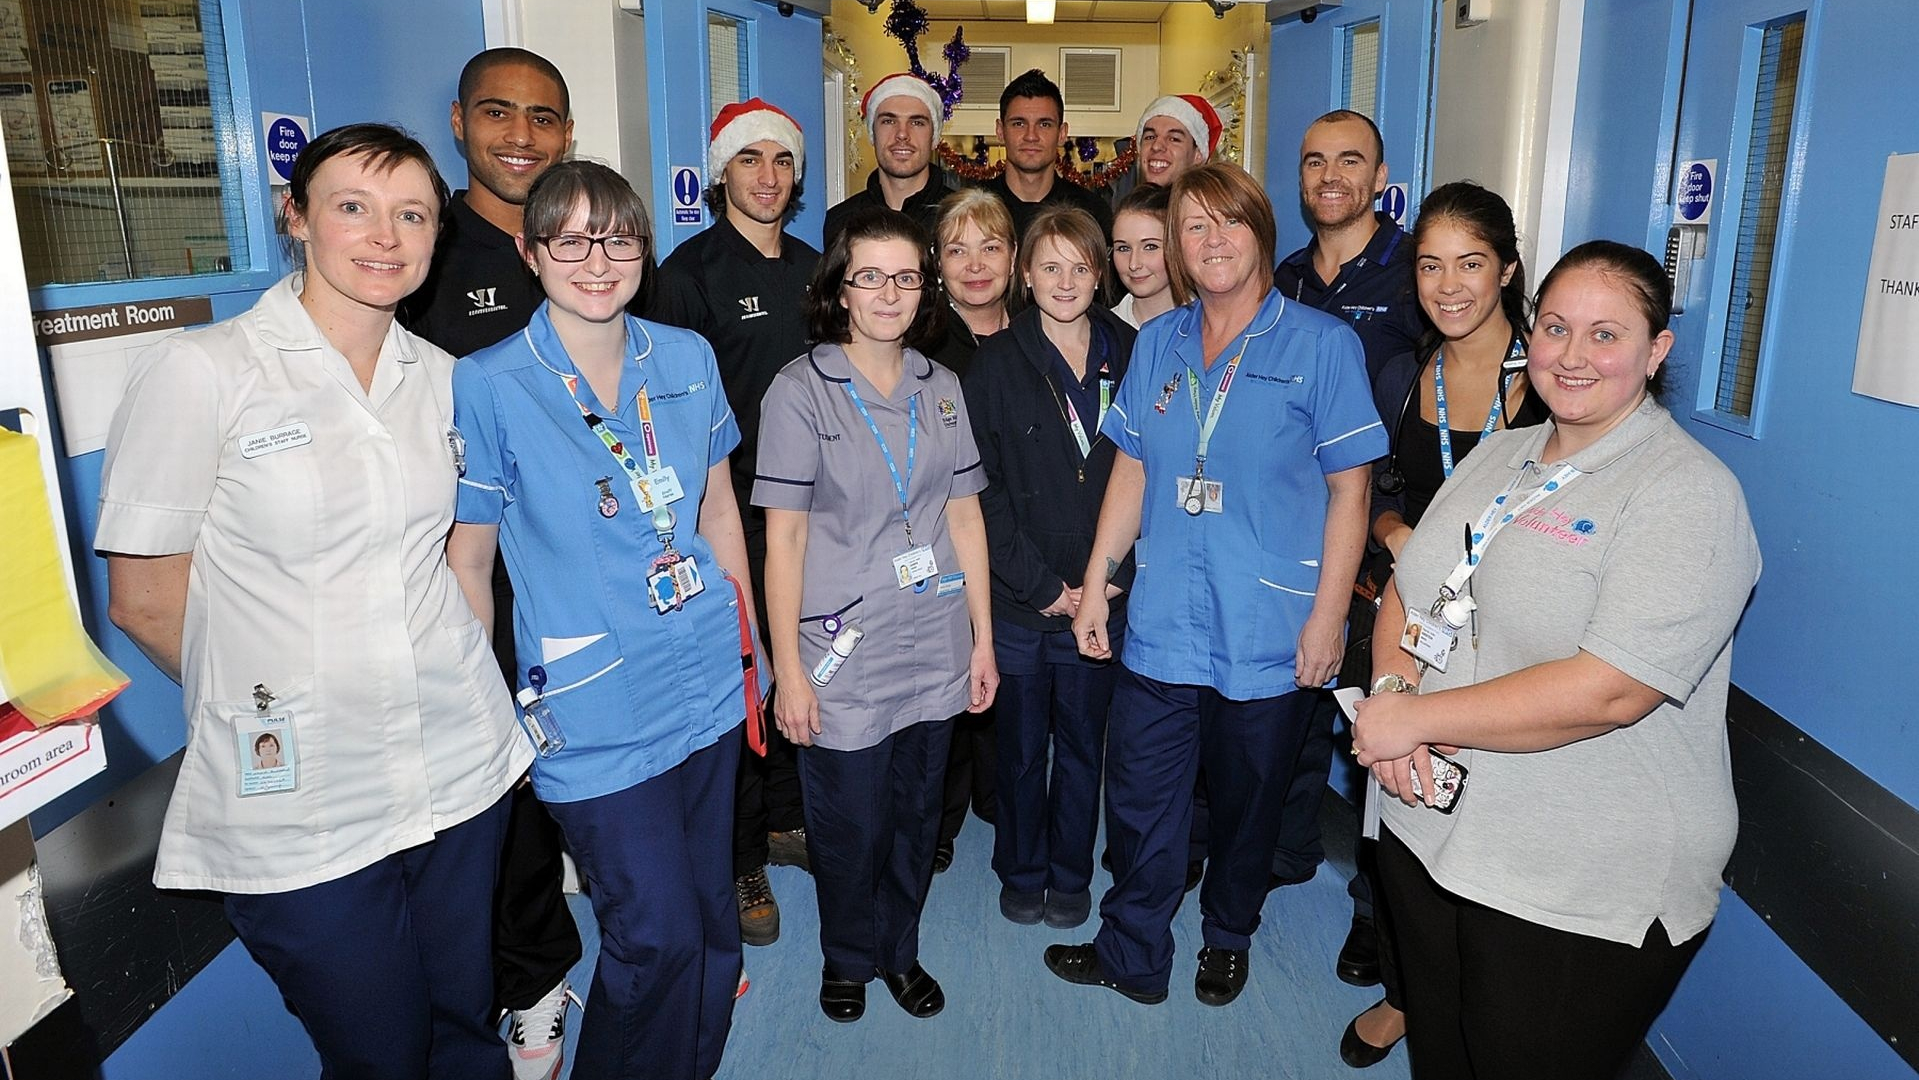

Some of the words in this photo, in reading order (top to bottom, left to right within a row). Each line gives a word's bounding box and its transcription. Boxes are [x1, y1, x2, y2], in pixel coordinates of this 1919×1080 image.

[279, 126, 295, 138] Fire
[279, 139, 298, 150] door
[270, 150, 290, 163] keep
[1690, 171, 1703, 181] Fire
[1687, 182, 1703, 192] door
[32, 308, 120, 337] reatment
[125, 305, 175, 325] Room
[688, 381, 705, 393] NHS
[1436, 385, 1445, 402] NHS
[1438, 407, 1447, 424] NHS
[1484, 415, 1497, 433] NHS
[247, 437, 267, 447] JANIE
[269, 428, 301, 441] BURRAGE
[1440, 428, 1449, 446] NHS
[1442, 451, 1452, 470] NHS
[1513, 514, 1590, 547] Volunteer
[46, 739, 74, 762] area
